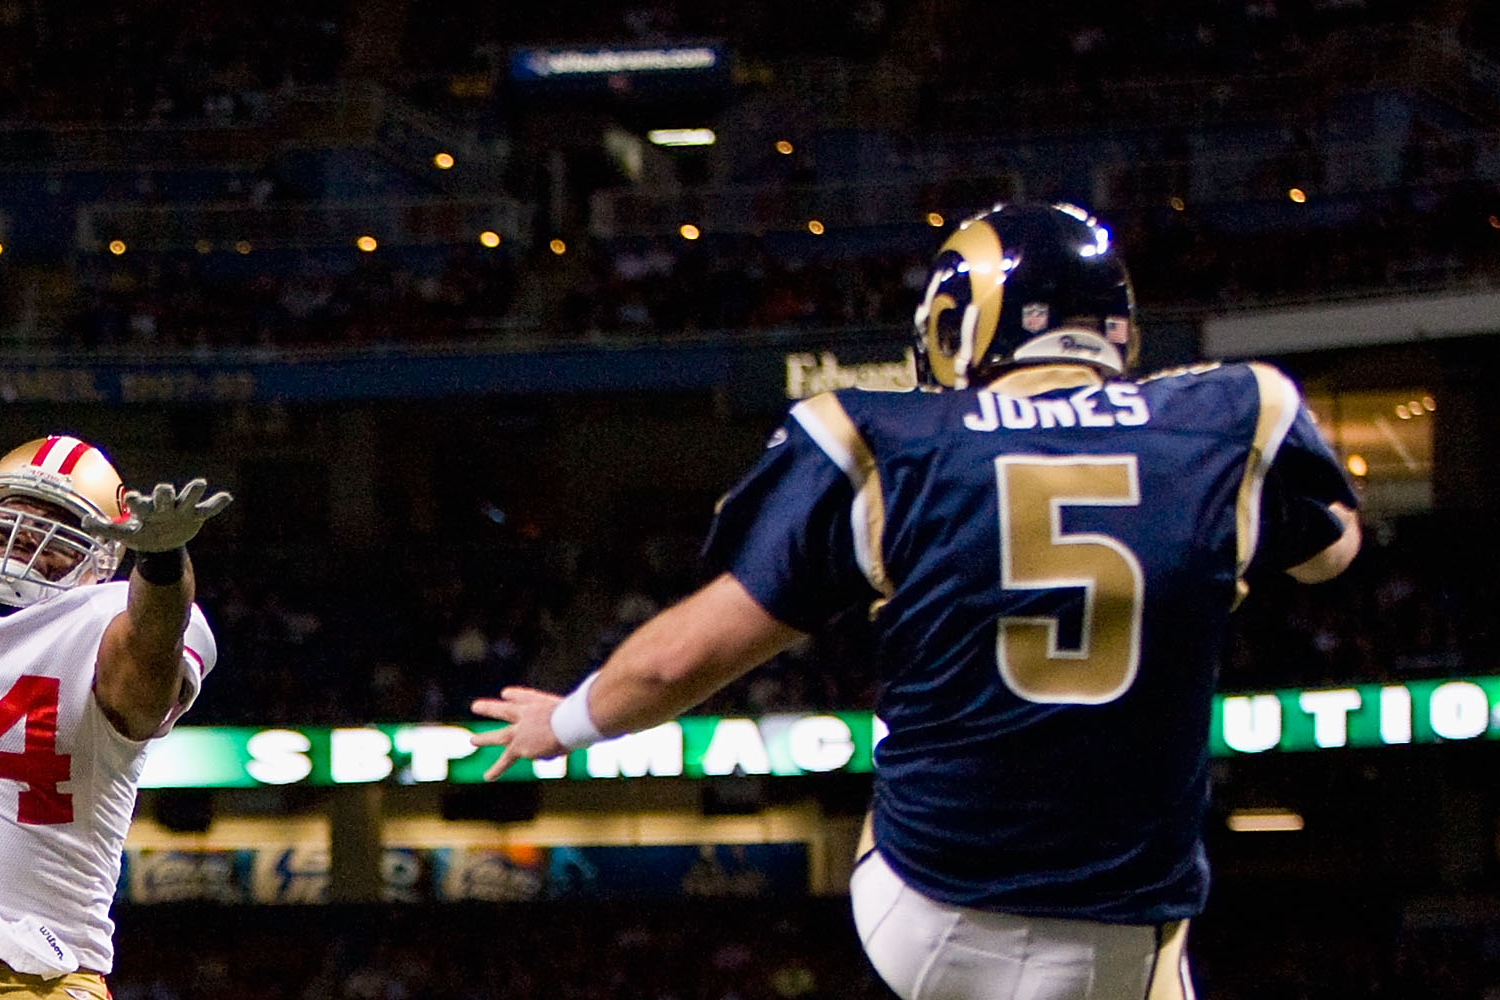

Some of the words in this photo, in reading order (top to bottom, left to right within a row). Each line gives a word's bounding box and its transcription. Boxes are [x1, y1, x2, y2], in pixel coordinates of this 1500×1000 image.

[963, 382, 1149, 432] JONES
[994, 454, 1144, 705] 5
[532, 712, 890, 779] MAG
